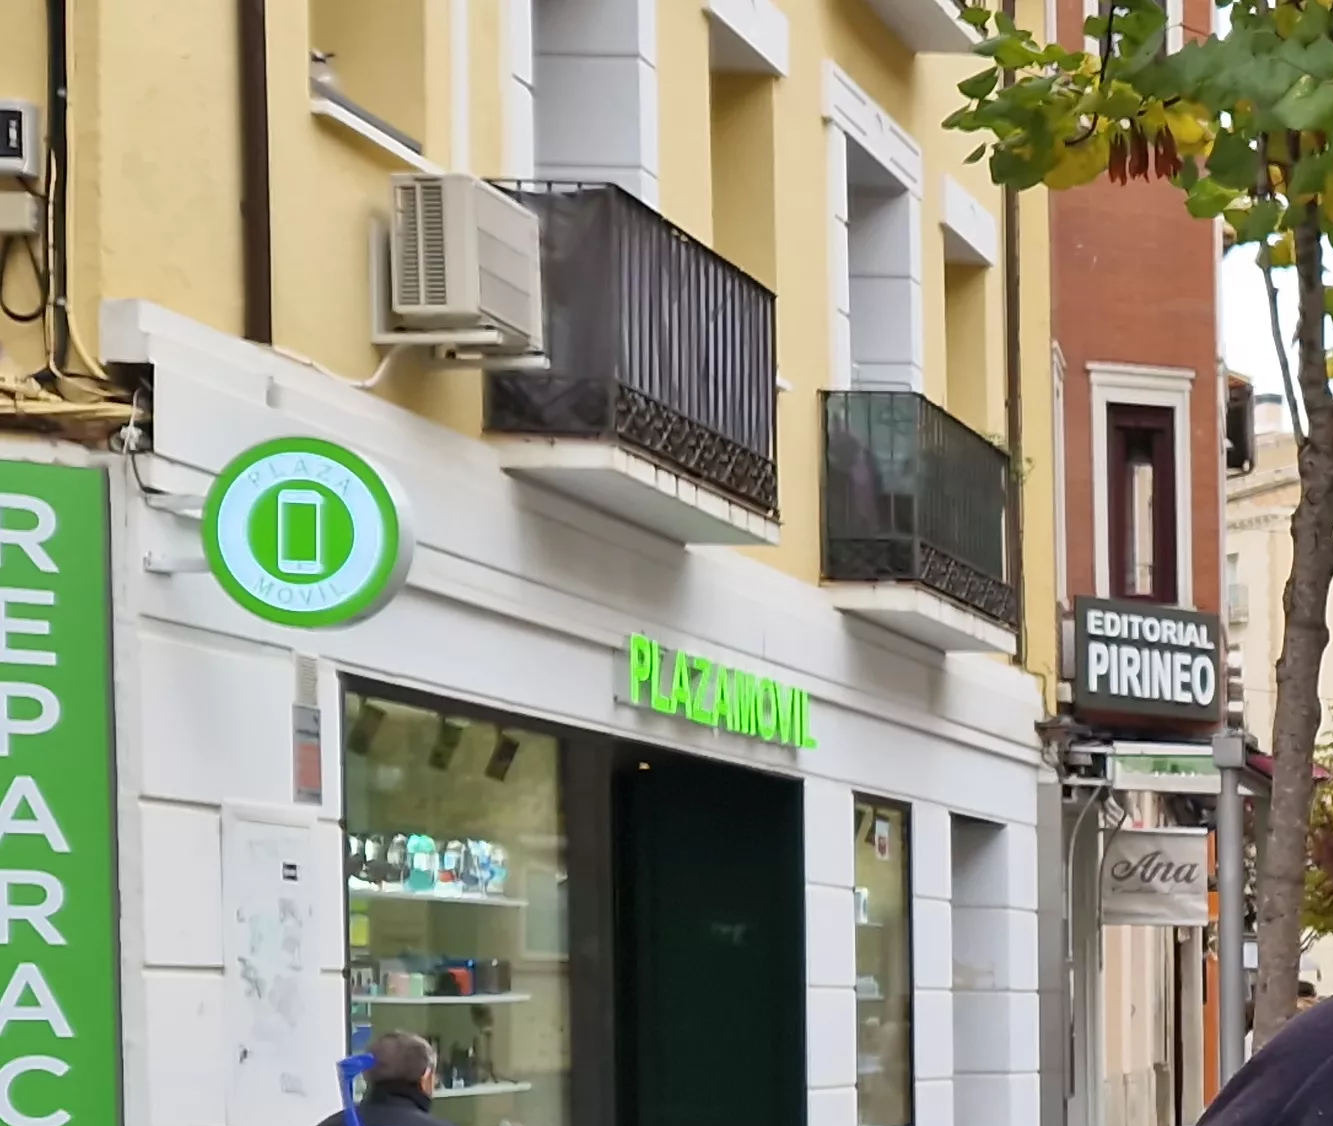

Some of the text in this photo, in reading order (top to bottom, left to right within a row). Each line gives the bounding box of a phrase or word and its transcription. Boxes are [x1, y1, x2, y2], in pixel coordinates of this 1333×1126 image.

[248, 459, 351, 497] PLAZA
[254, 576, 346, 606] MOVIL
[1087, 609, 1215, 650] EDITORIAL
[631, 632, 818, 749] PLAZAMOVIL
[1088, 641, 1216, 707] PIRINEO
[1111, 850, 1200, 884] Ana
